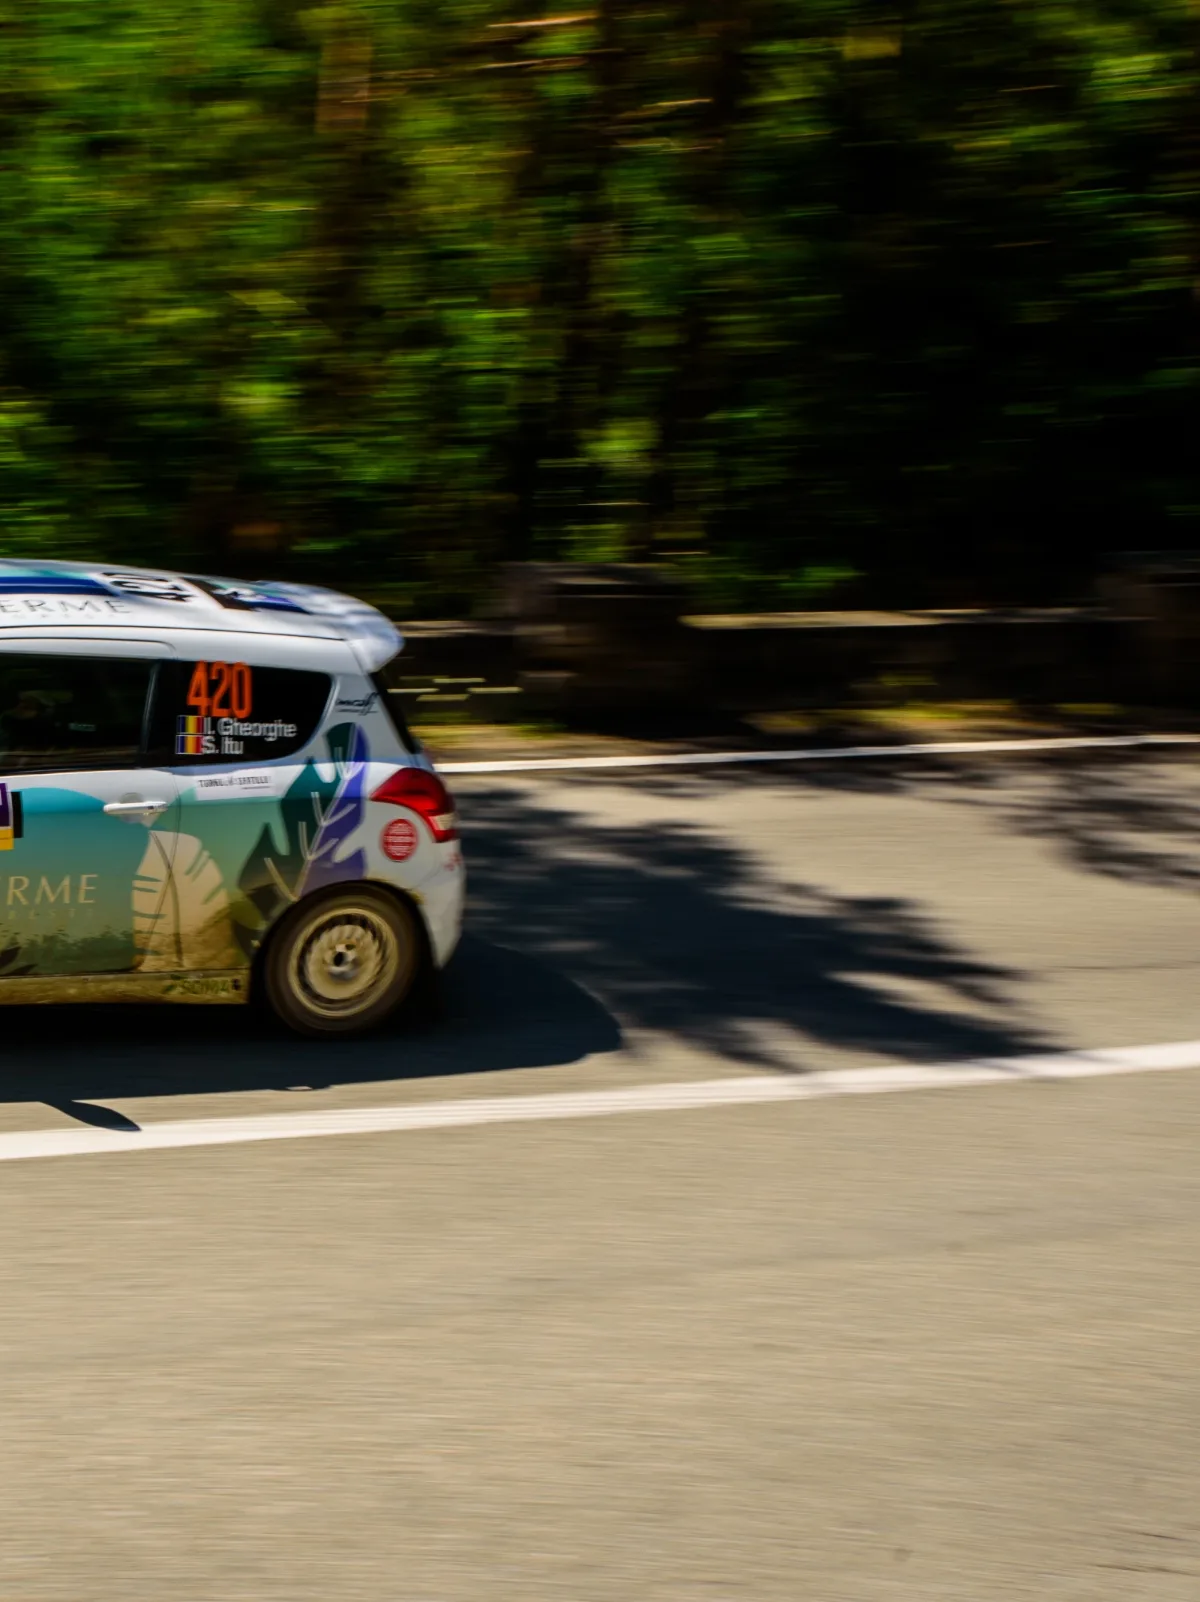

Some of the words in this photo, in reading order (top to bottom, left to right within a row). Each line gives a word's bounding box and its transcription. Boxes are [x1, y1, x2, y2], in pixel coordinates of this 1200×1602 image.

[187, 660, 252, 719] 420
[217, 717, 297, 741] Gheorghe
[201, 735, 219, 754] S.
